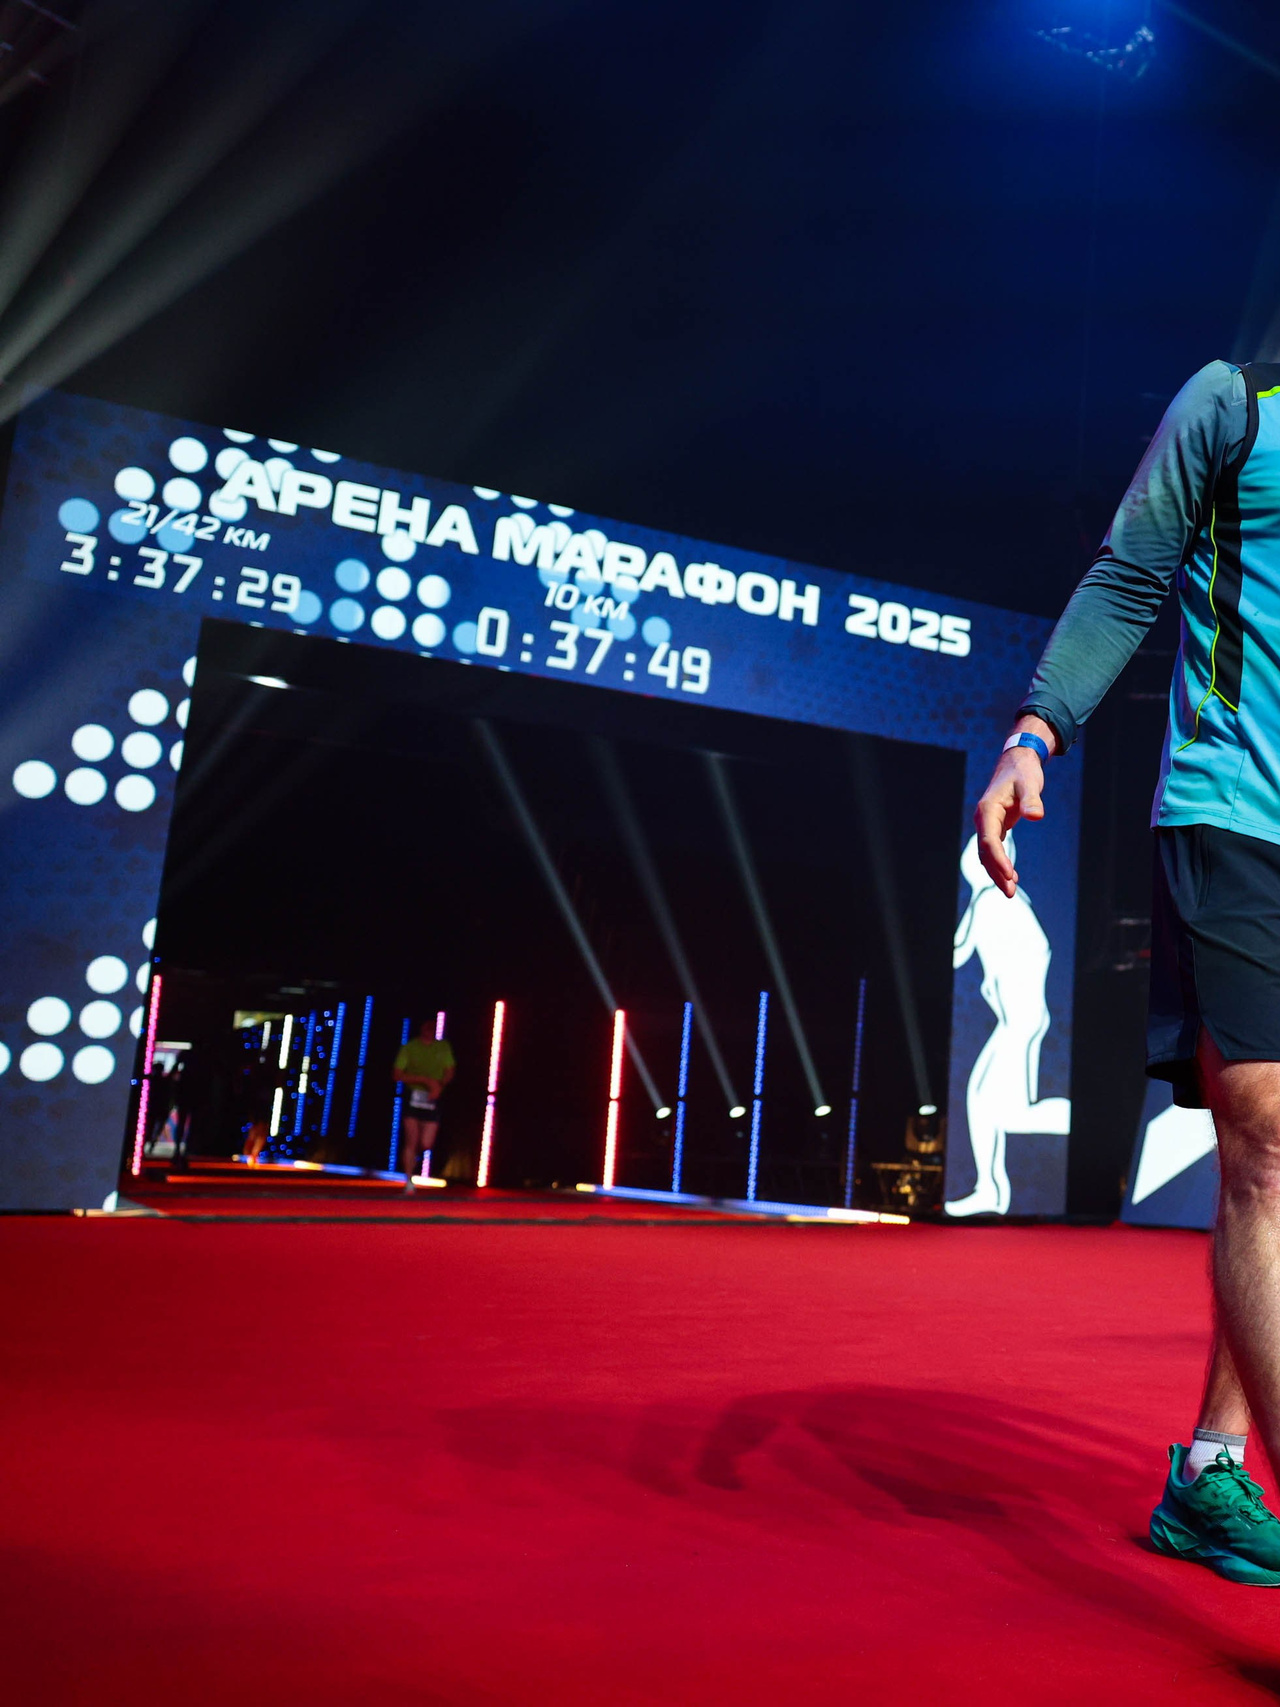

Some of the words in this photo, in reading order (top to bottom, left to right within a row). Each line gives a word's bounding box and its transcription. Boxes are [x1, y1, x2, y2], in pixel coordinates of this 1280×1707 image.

[120, 501, 220, 540] 21/42
[218, 459, 480, 555] АРЕНА
[492, 515, 821, 627] МАРАФОН
[844, 593, 972, 658] 2025
[60, 532, 303, 614] 3:37:29
[543, 581, 581, 611] 10
[475, 606, 712, 695] 0:37:49
